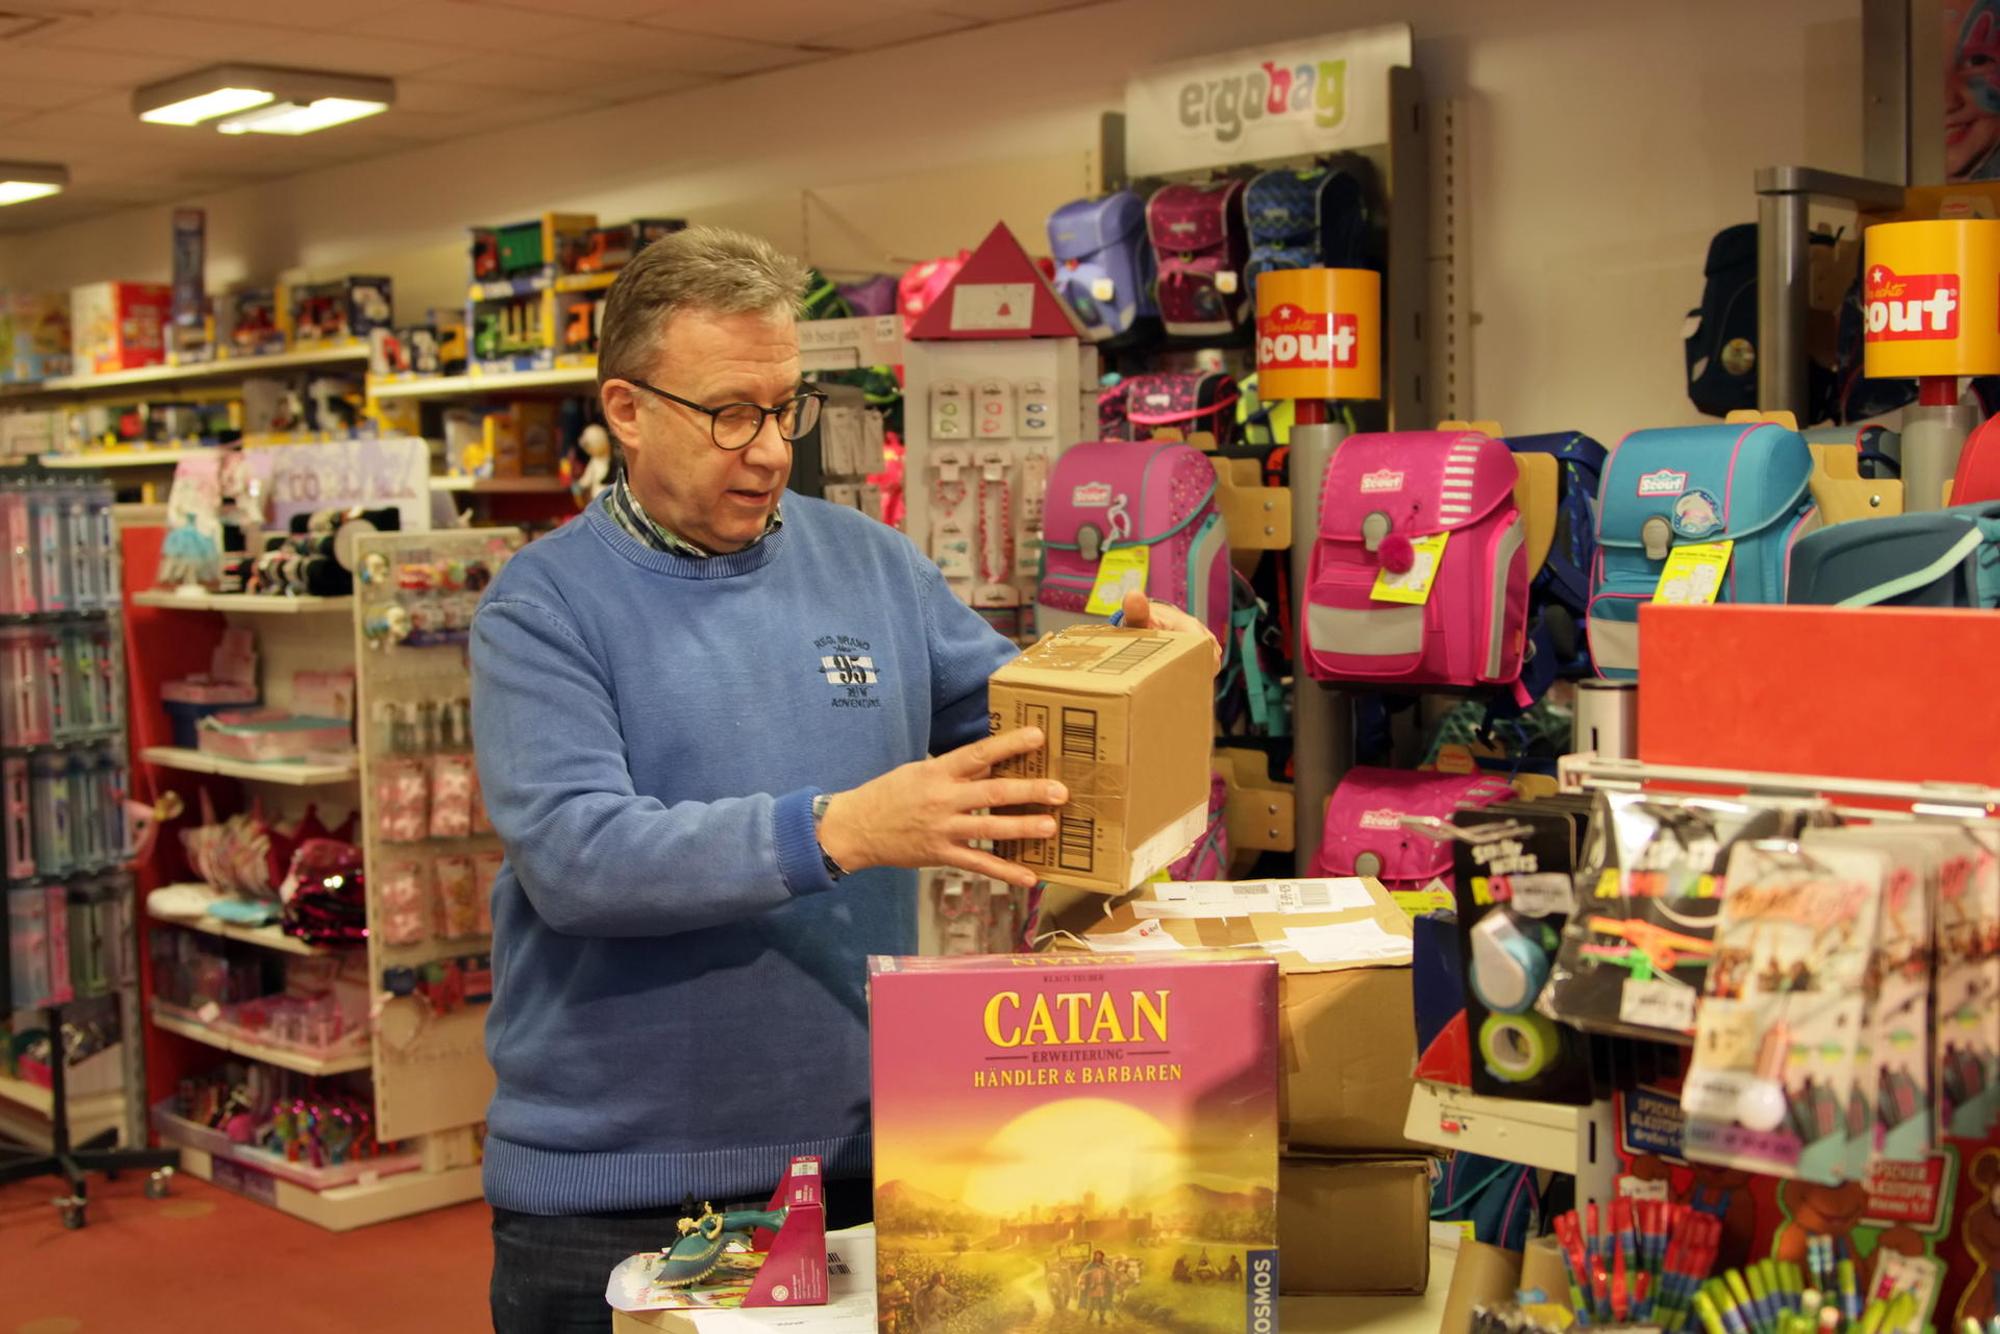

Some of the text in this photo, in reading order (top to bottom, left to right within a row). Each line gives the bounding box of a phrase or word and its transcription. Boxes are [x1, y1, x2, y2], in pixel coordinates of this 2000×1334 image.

[1179, 59, 1347, 142] ergobag
[1363, 477, 1401, 489] Scout
[1642, 479, 1682, 492] Scout
[833, 654, 867, 684] 95
[983, 989, 1171, 1049] CATAN
[1031, 1048, 1124, 1063] ERWEITERUNG
[973, 1063, 1184, 1088] HÄNDLER & BARBAREN
[1253, 1258, 1272, 1334] OSMOS
